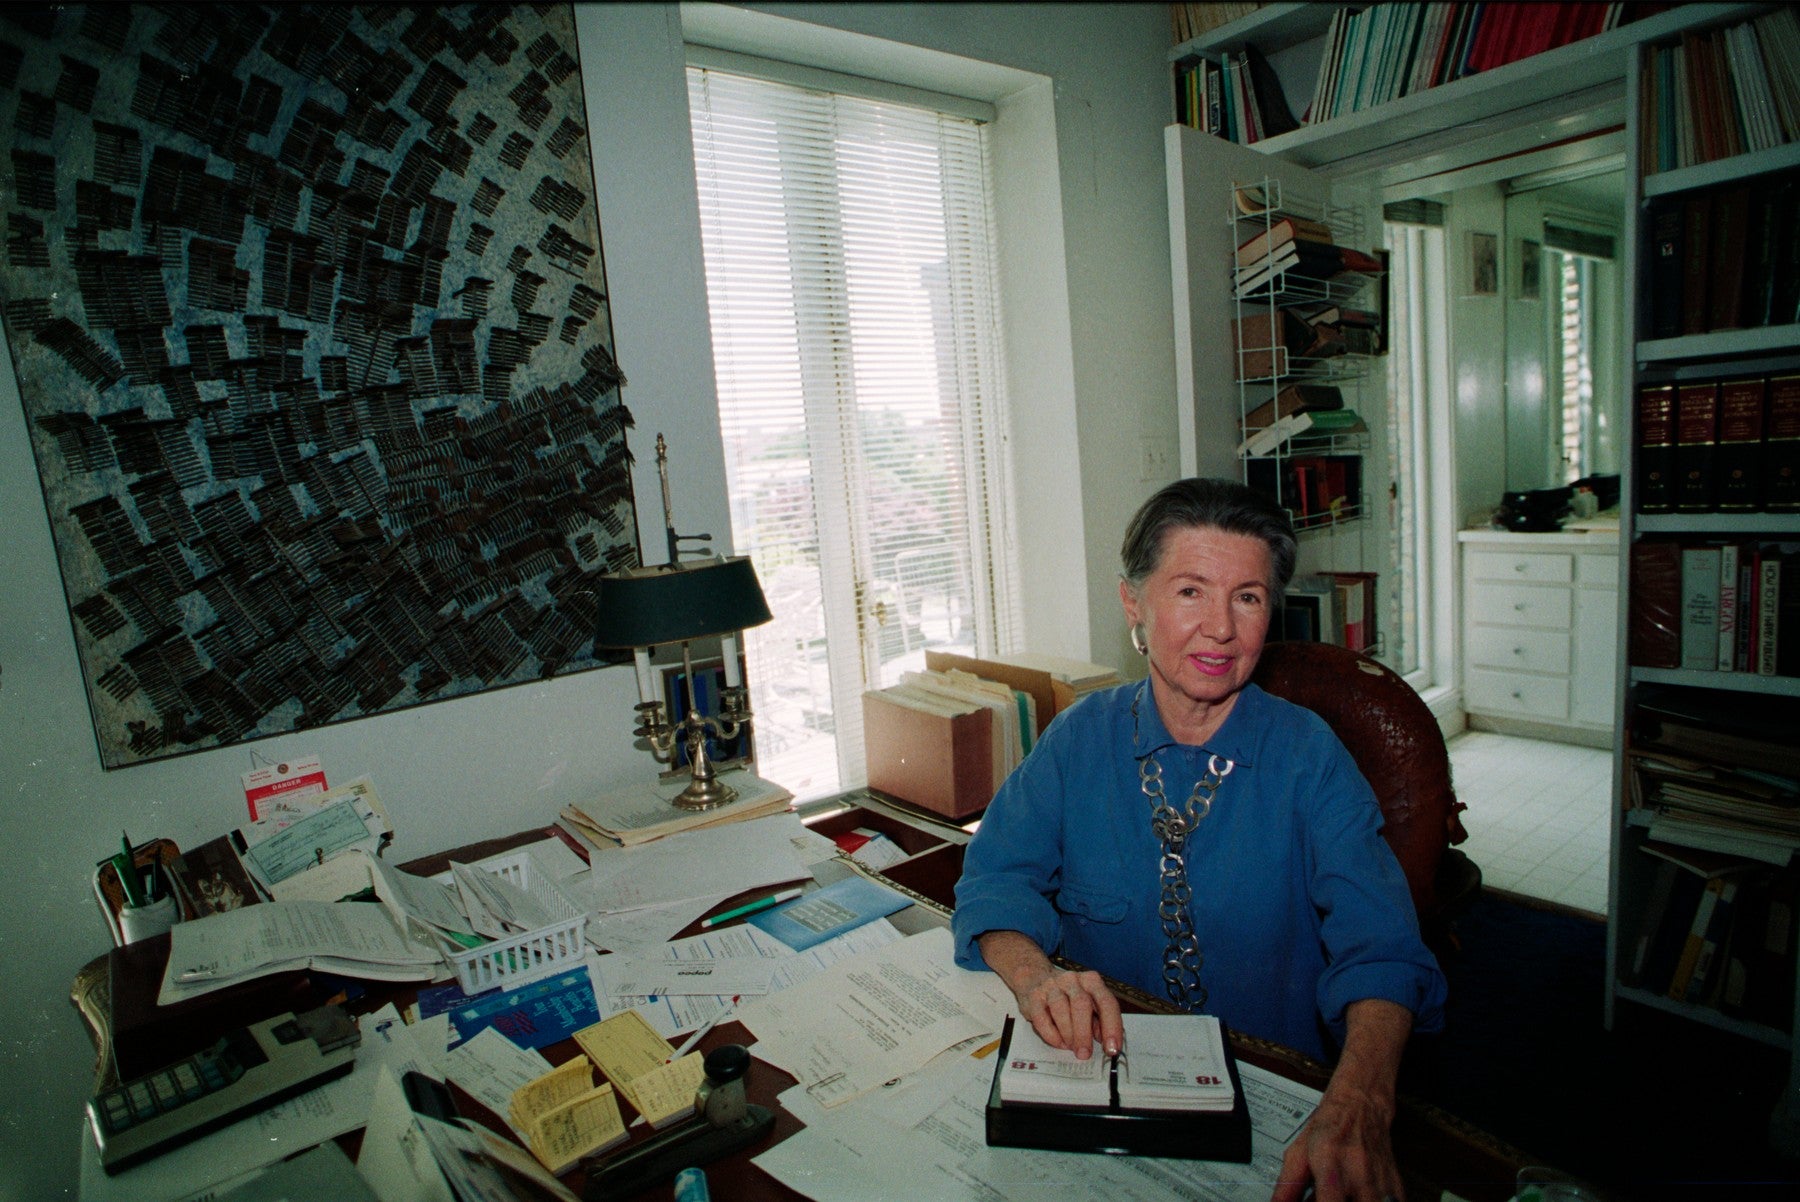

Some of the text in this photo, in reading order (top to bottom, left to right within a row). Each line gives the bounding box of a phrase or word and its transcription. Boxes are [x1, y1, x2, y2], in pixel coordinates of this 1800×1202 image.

[1764, 565, 1776, 586] HOW
[1764, 587, 1775, 598] TO
[272, 779, 302, 790] DANGER
[1011, 1061, 1039, 1071] 18
[1195, 1075, 1223, 1086] 18
